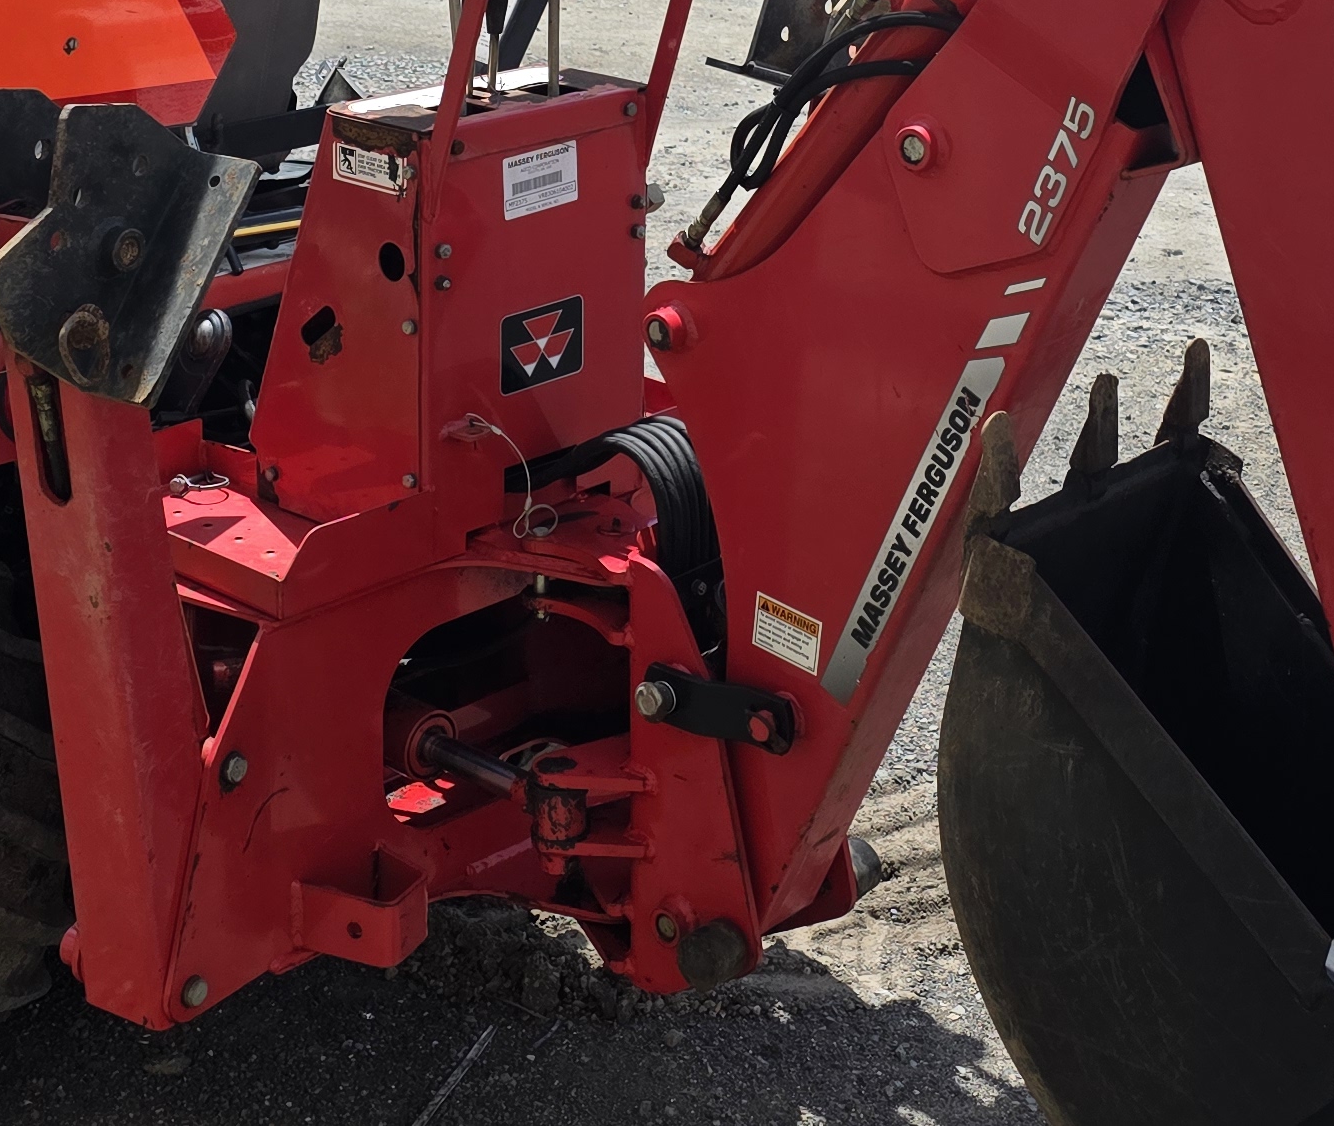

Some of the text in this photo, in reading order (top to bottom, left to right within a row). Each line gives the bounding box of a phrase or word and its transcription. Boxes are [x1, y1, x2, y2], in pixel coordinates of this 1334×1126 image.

[507, 147, 570, 169] MASSEY FERGUSON
[1018, 96, 1095, 245] 2375
[851, 386, 982, 650] MASSEY FERGUSON
[771, 604, 817, 634] WARNING
